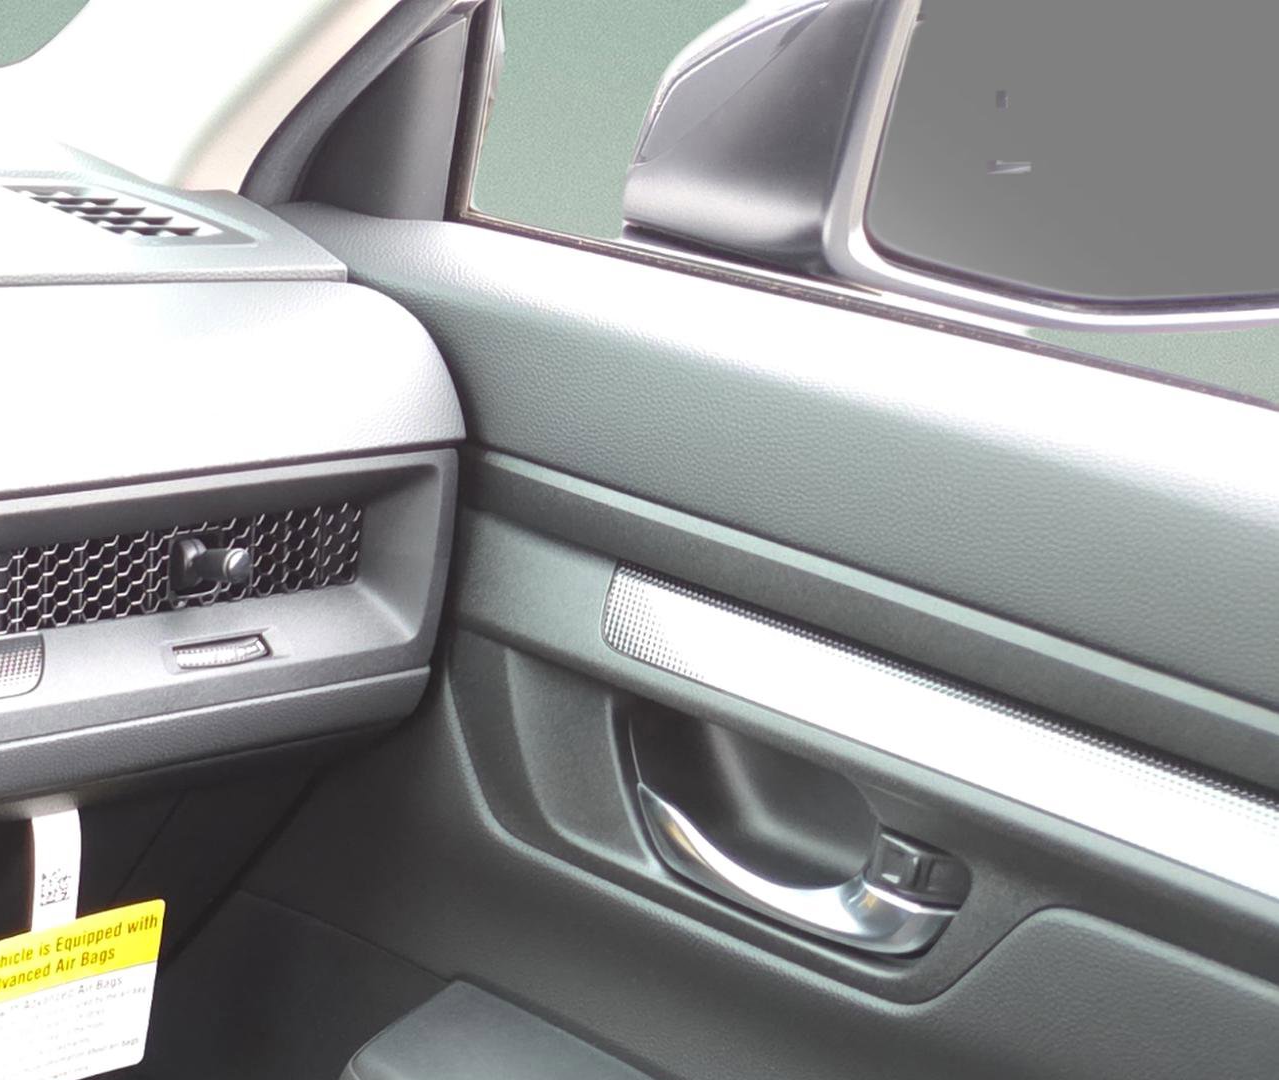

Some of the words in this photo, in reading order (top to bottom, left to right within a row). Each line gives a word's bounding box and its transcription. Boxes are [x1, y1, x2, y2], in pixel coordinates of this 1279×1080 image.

[39, 943, 50, 957] is
[56, 923, 122, 953] Equipped
[127, 914, 158, 934] with
[56, 958, 75, 974] Air
[81, 947, 115, 966] Bags
